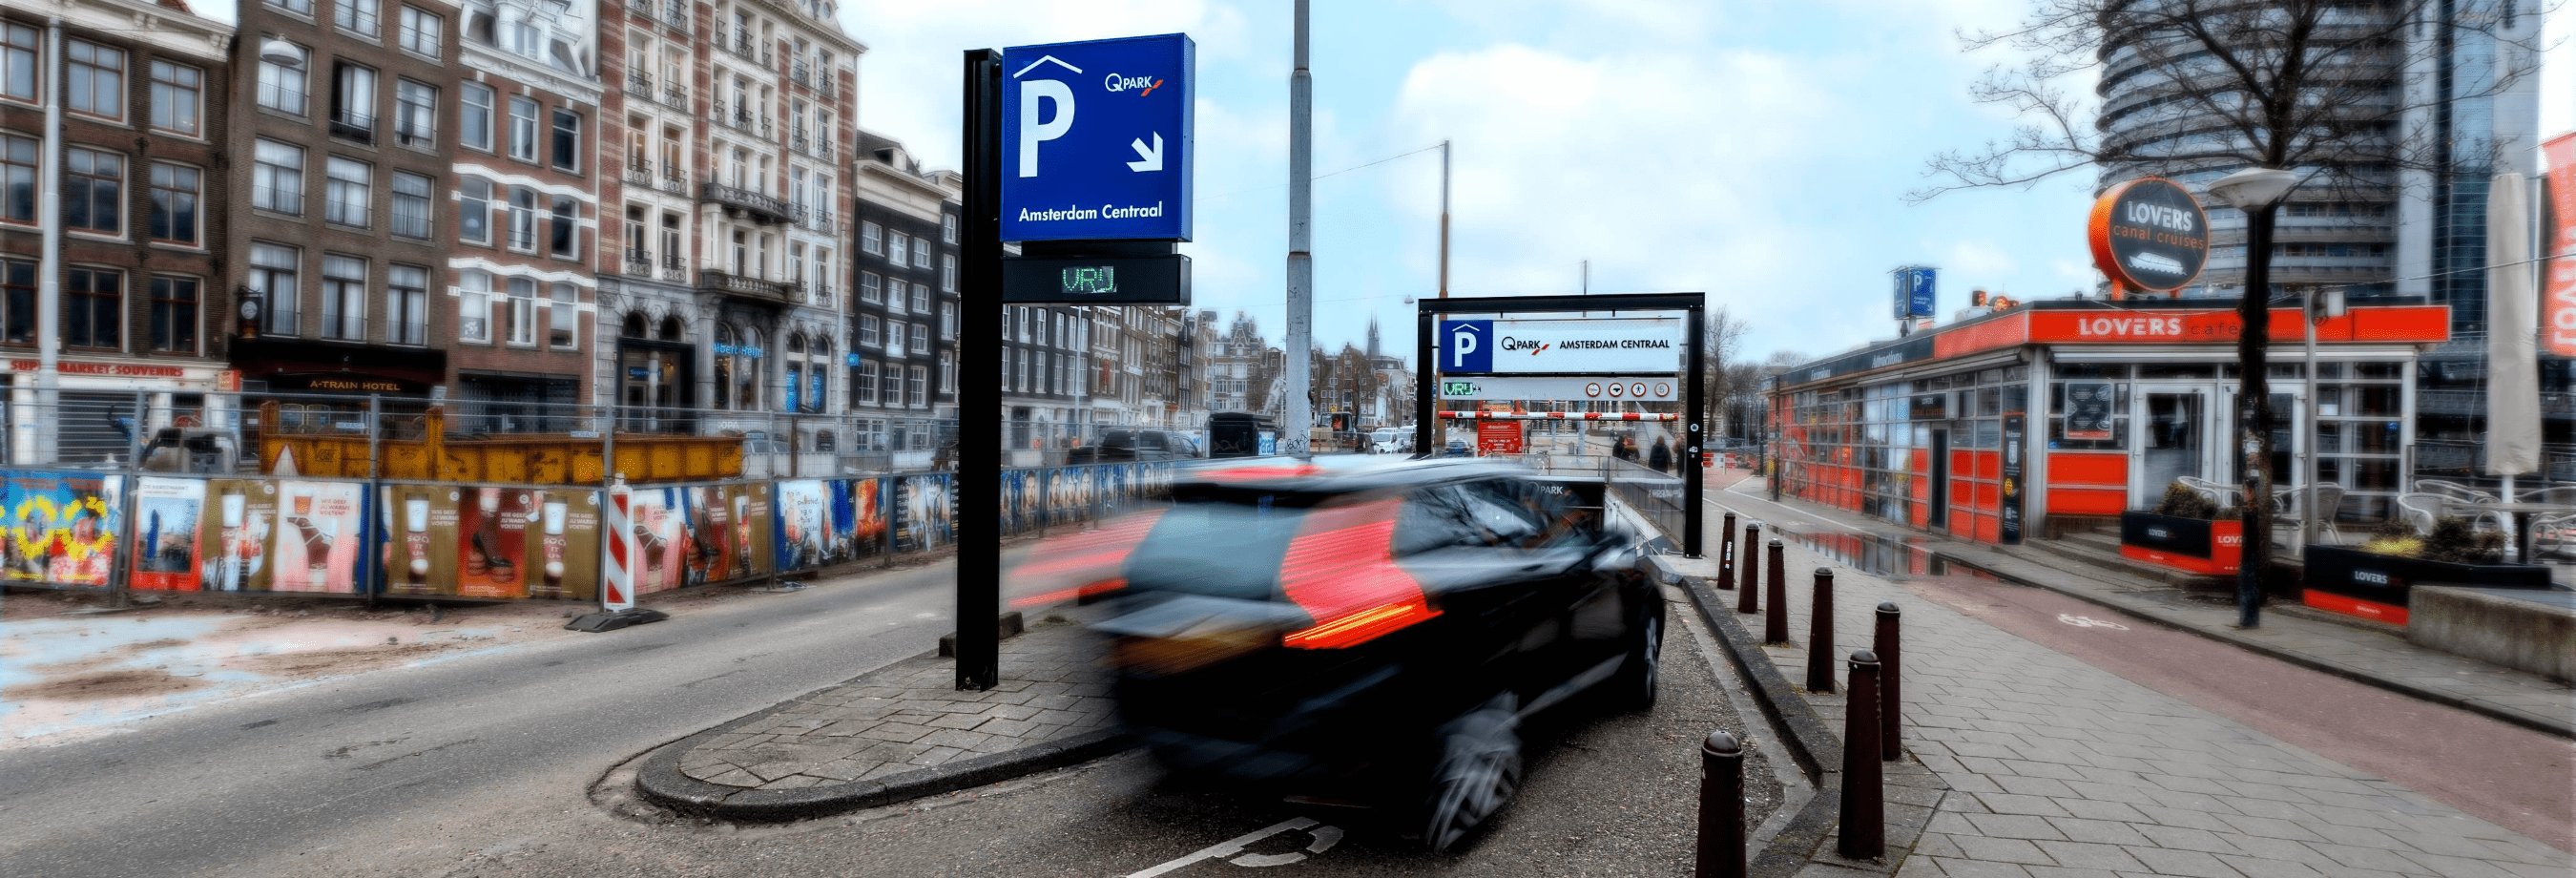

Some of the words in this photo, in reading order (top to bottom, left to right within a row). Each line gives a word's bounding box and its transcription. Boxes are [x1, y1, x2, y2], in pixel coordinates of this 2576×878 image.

[1019, 79, 1075, 178] P
[1019, 204, 1097, 221] Amsterdam
[1102, 200, 1163, 220] Centraal
[2128, 200, 2193, 231] LOVERS
[2113, 225, 2151, 240] canal
[2157, 232, 2204, 249] cruises
[2079, 318, 2182, 335] LOVERS
[2190, 322, 2238, 335] café
[1454, 331, 1477, 367] P
[1559, 340, 1618, 349] AMSTERDAM
[1620, 339, 1671, 348] CENTRAAL
[310, 380, 359, 389] A-TRAIN
[363, 382, 401, 391] HOTEL
[2148, 529, 2167, 537] LOVERS
[2354, 571, 2388, 584] LOVERS
